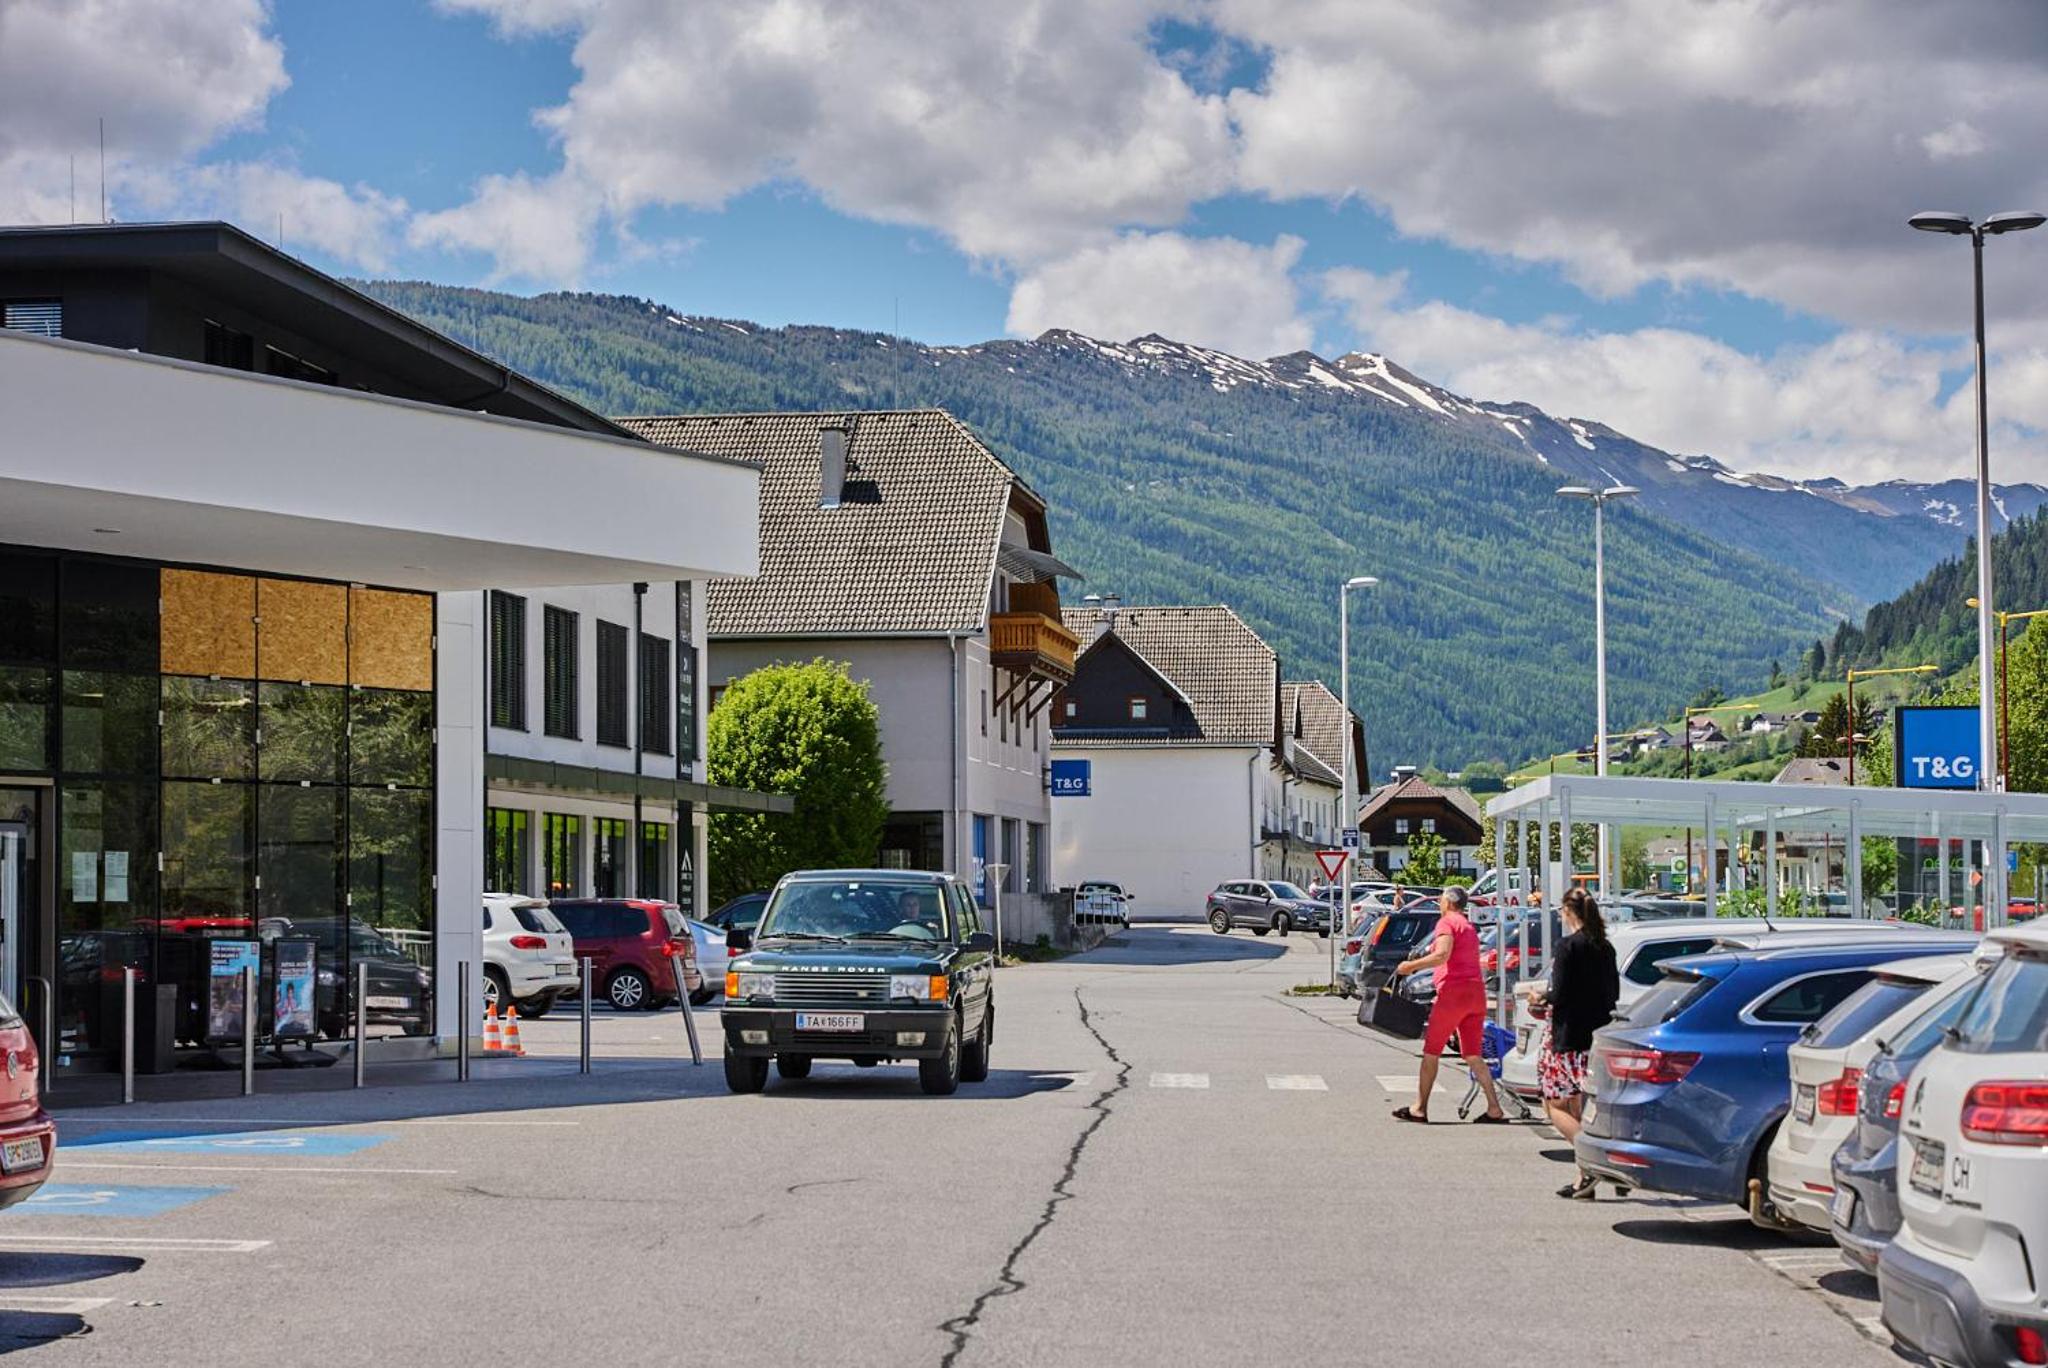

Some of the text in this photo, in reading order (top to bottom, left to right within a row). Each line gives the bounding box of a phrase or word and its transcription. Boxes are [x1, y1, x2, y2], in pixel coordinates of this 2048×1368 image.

[1912, 756, 1974, 778] T&G
[1055, 778, 1083, 789] T&G
[1953, 1156, 1969, 1190] CH
